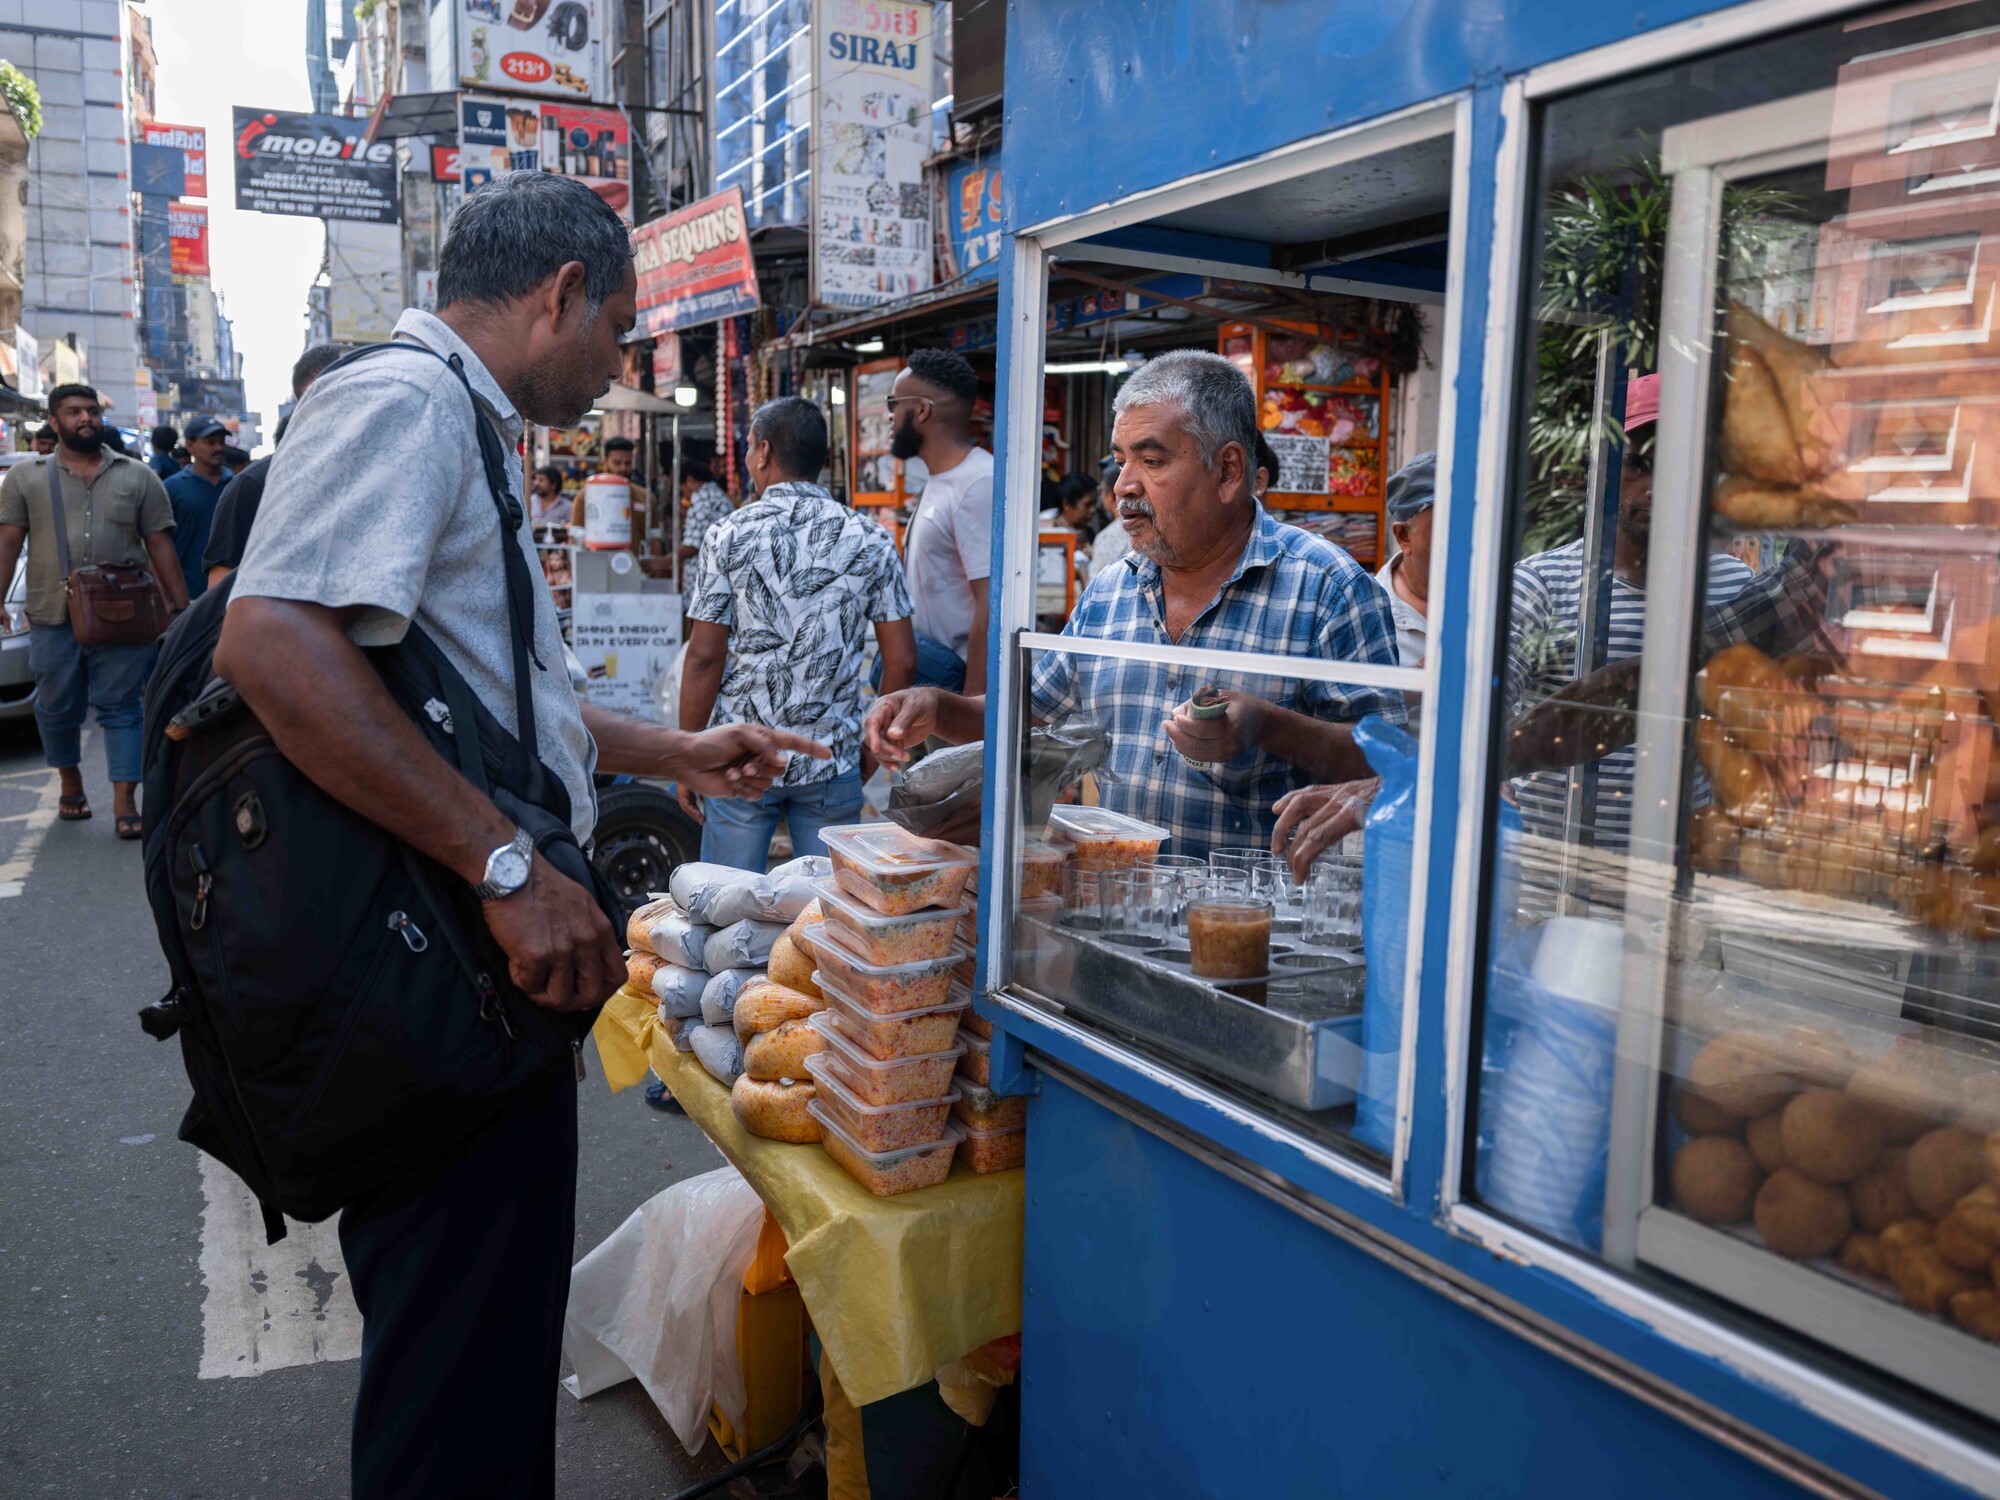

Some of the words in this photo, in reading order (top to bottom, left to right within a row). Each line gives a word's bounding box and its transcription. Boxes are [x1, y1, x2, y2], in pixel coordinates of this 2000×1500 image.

[829, 31, 917, 70] SIRAJ
[507, 58, 544, 77] 213/1
[250, 178, 316, 193] WHOLESALE
[319, 184, 342, 195] AND
[263, 171, 305, 184] DIRECT
[306, 175, 370, 189] IMPORTERS
[660, 204, 741, 264] SEQUINS
[619, 625, 668, 634] ENERGY
[609, 638, 649, 647] EVERY
[652, 638, 677, 647] CUP
